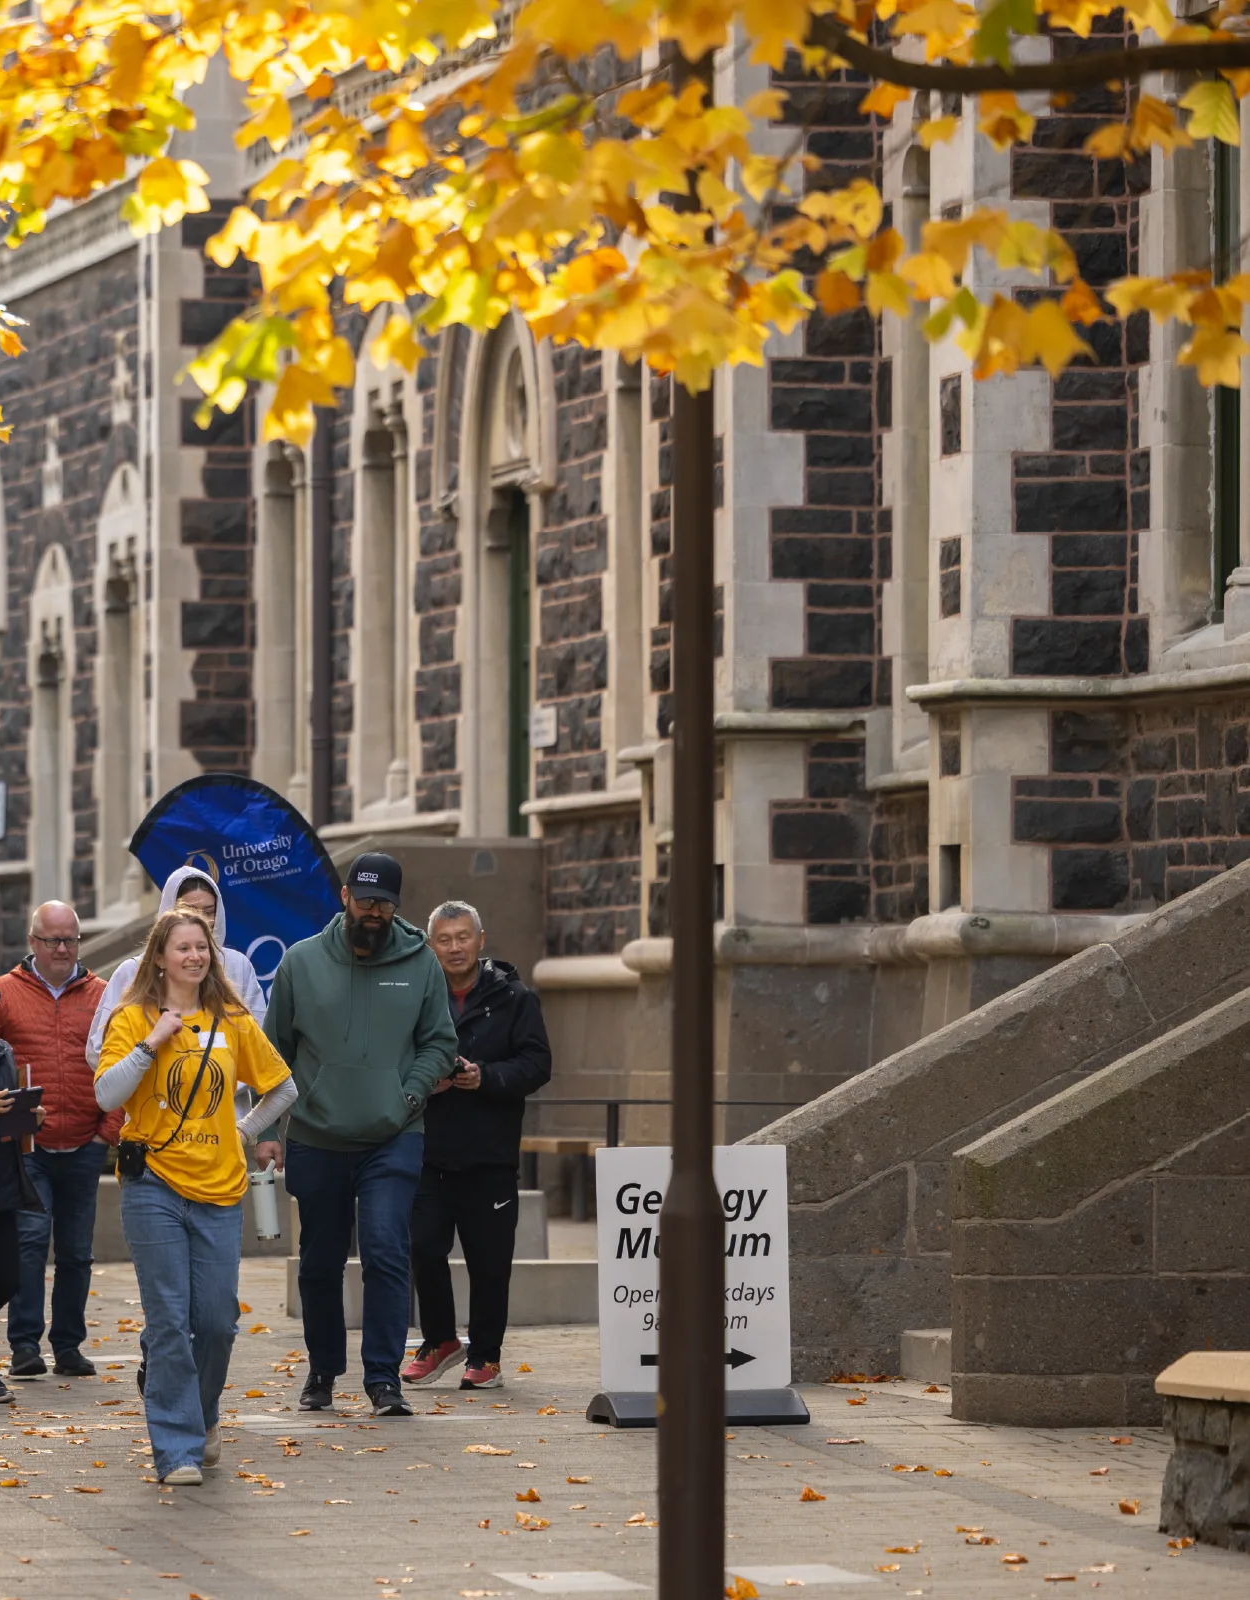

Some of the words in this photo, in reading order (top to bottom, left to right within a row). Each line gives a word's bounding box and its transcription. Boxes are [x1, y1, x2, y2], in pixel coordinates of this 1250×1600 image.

[222, 834, 292, 859] University
[224, 860, 240, 876] of
[243, 855, 288, 873] Otago
[170, 1129, 193, 1143] Kia
[196, 1132, 219, 1144] ora
[616, 1182, 768, 1222] Gegy
